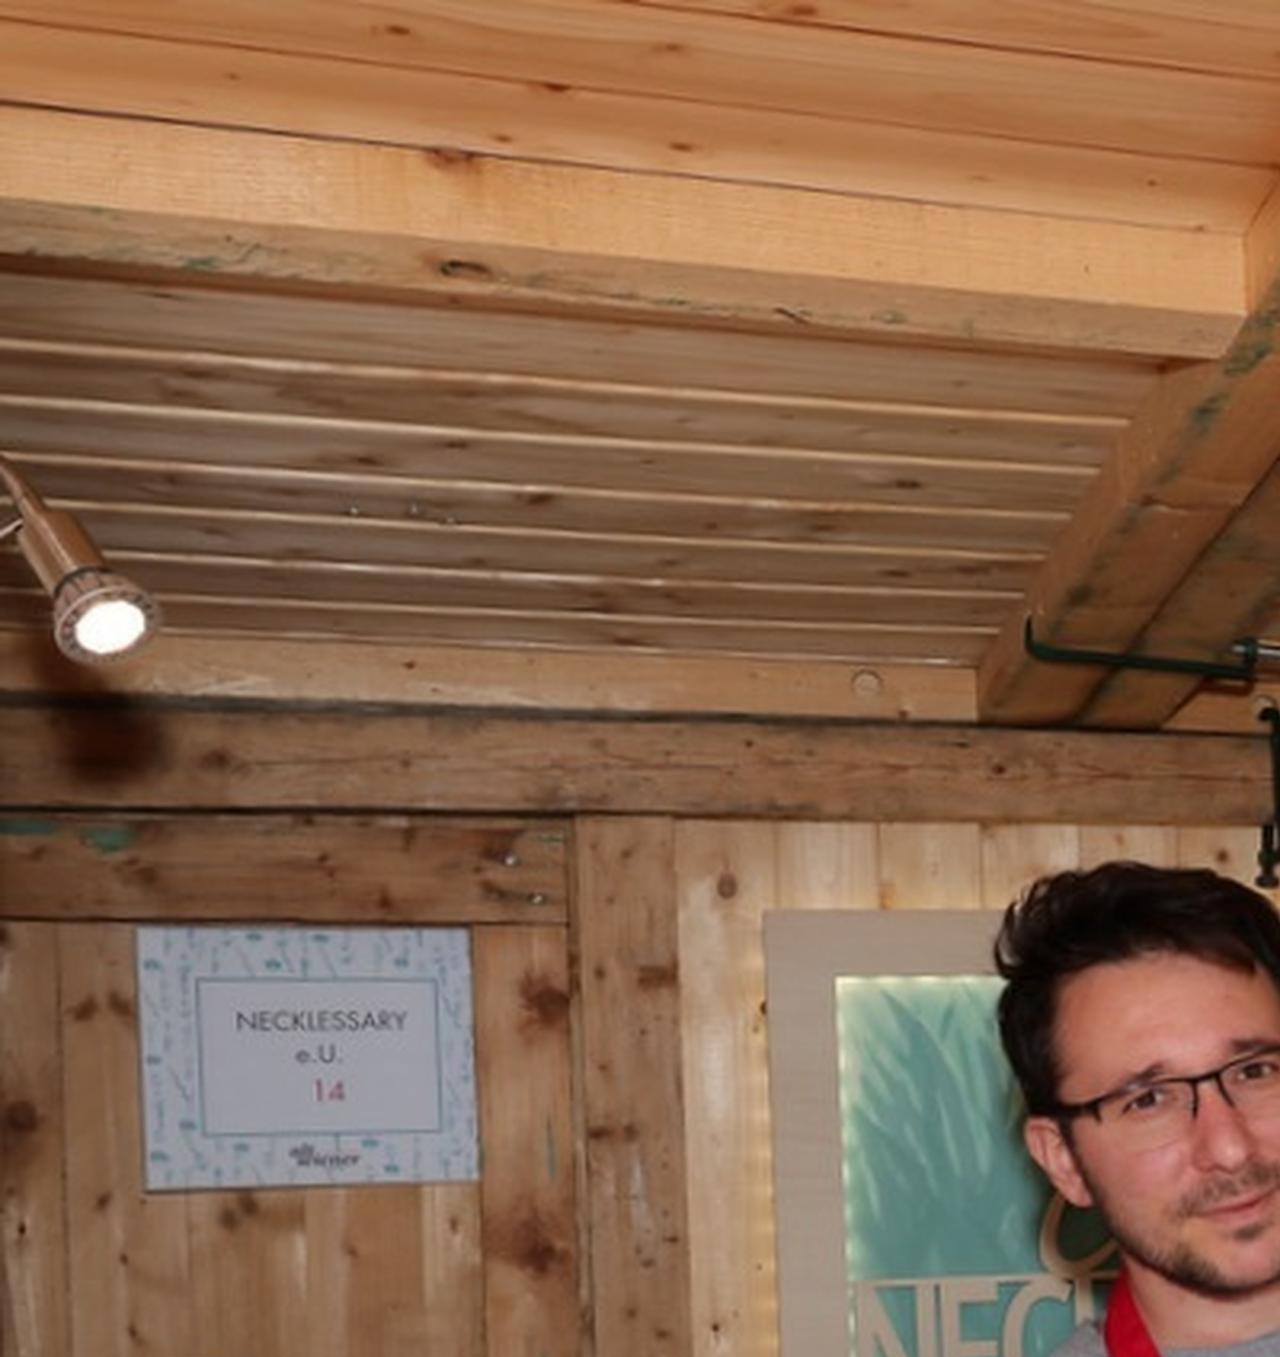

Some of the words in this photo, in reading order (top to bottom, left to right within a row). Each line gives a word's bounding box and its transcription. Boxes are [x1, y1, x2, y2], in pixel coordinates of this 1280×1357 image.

[235, 1010, 407, 1032] NECKLESSARY
[294, 1045, 344, 1065] e.U.
[314, 1078, 346, 1102] 14
